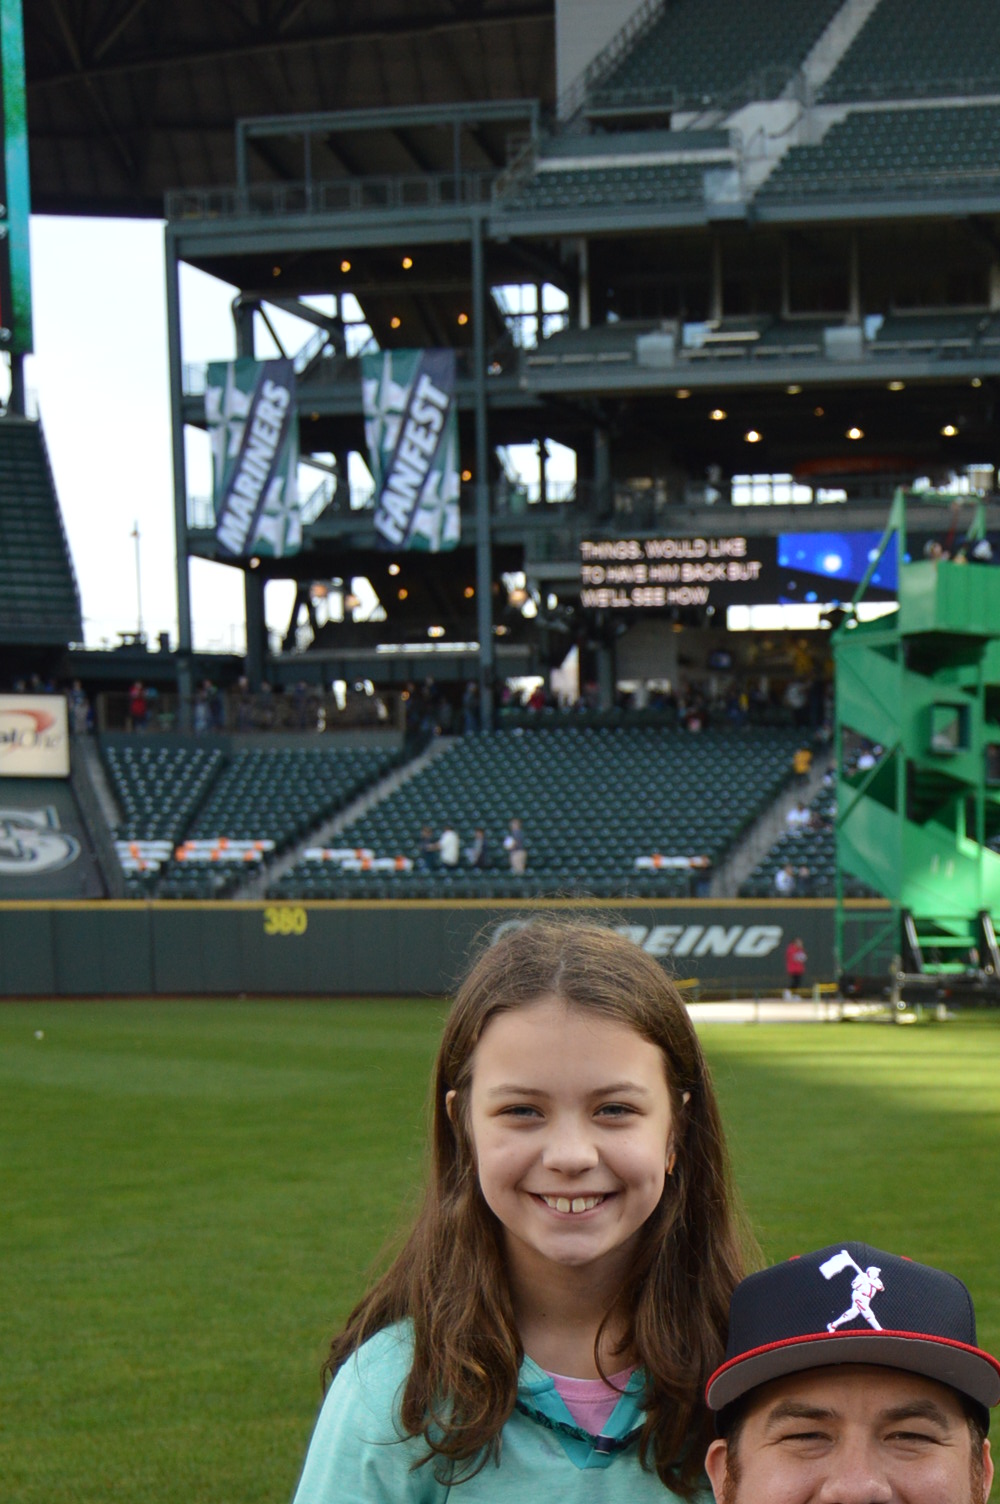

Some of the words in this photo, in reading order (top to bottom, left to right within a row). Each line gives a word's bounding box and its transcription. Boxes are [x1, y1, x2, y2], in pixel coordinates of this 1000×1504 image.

[217, 380, 290, 553] MARINERS
[374, 374, 449, 545] FANFEST
[645, 538, 708, 558] WOULD
[708, 537, 748, 557] LIKE
[580, 565, 606, 584] TO
[681, 562, 727, 582] BACK
[727, 561, 762, 581] BUT
[631, 586, 666, 606] SEE
[667, 586, 710, 605] HOW
[264, 908, 307, 935] 380
